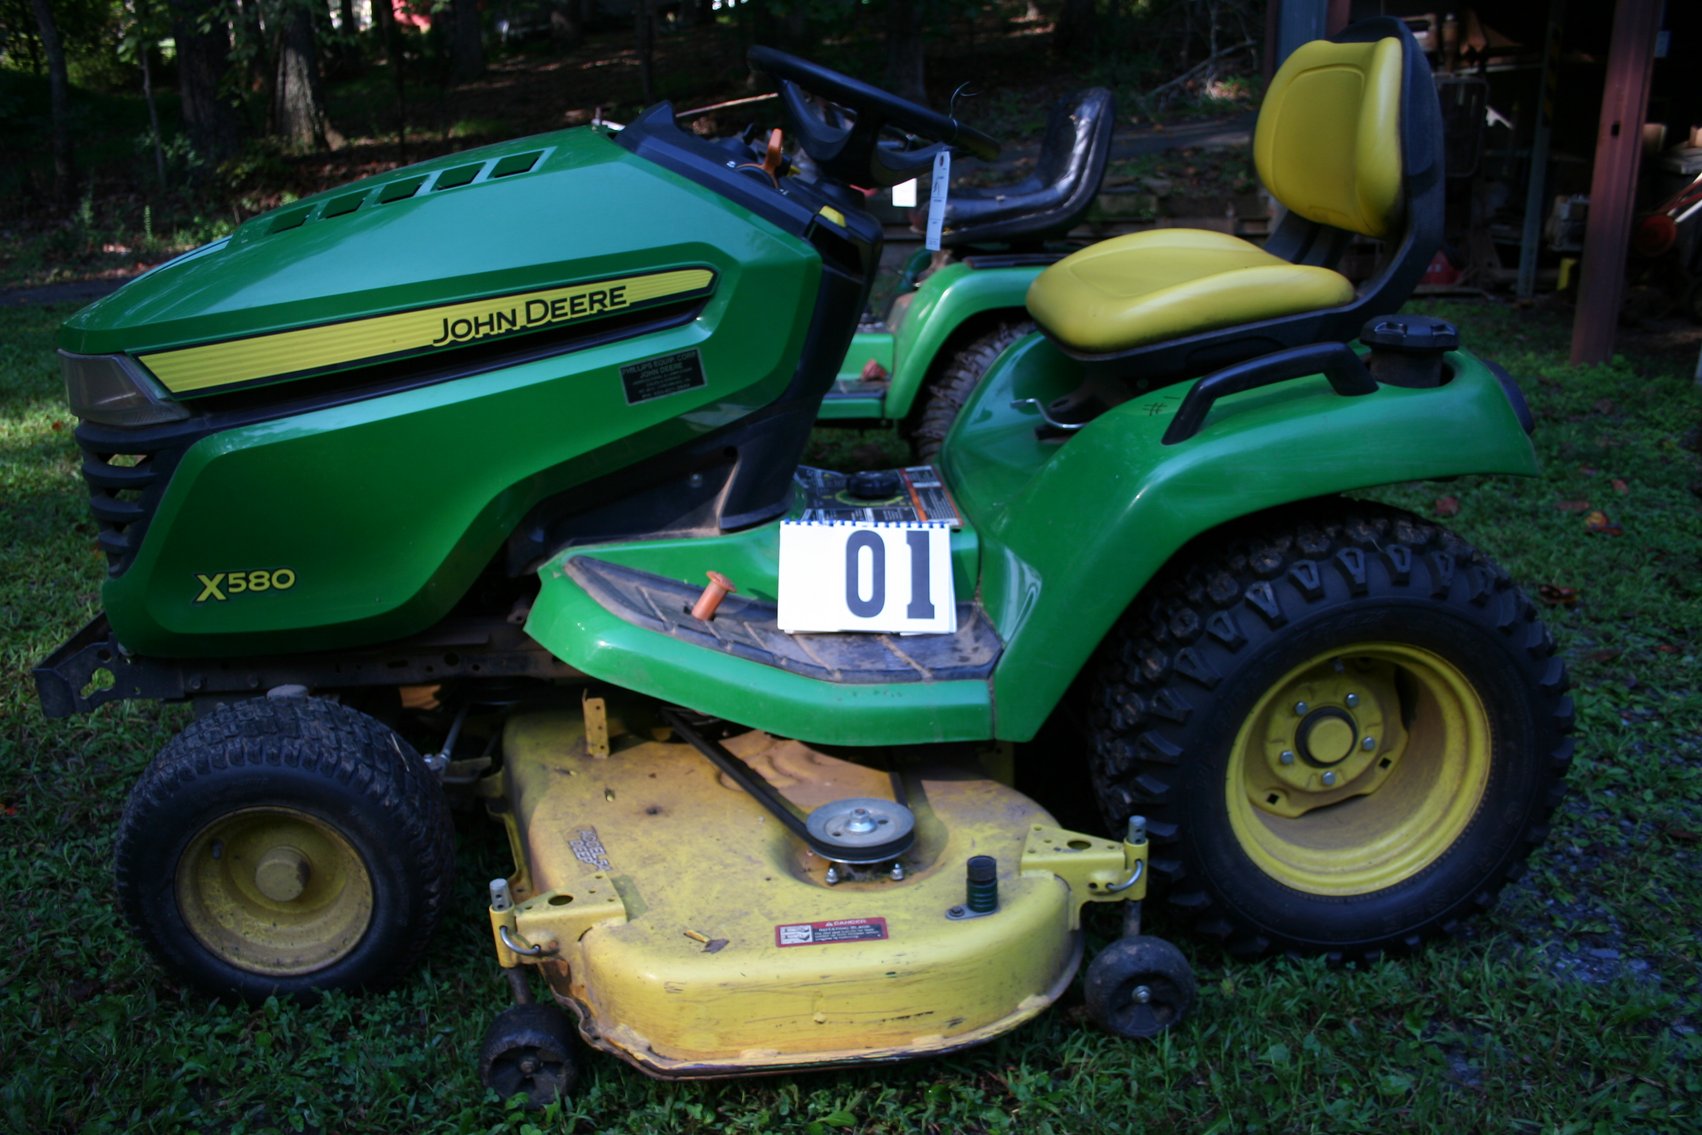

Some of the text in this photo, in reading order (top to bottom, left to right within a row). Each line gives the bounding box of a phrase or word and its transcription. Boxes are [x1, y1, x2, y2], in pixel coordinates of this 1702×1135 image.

[433, 284, 627, 344] JOHN DEERE
[195, 568, 296, 602] X580
[846, 530, 935, 620] 01
